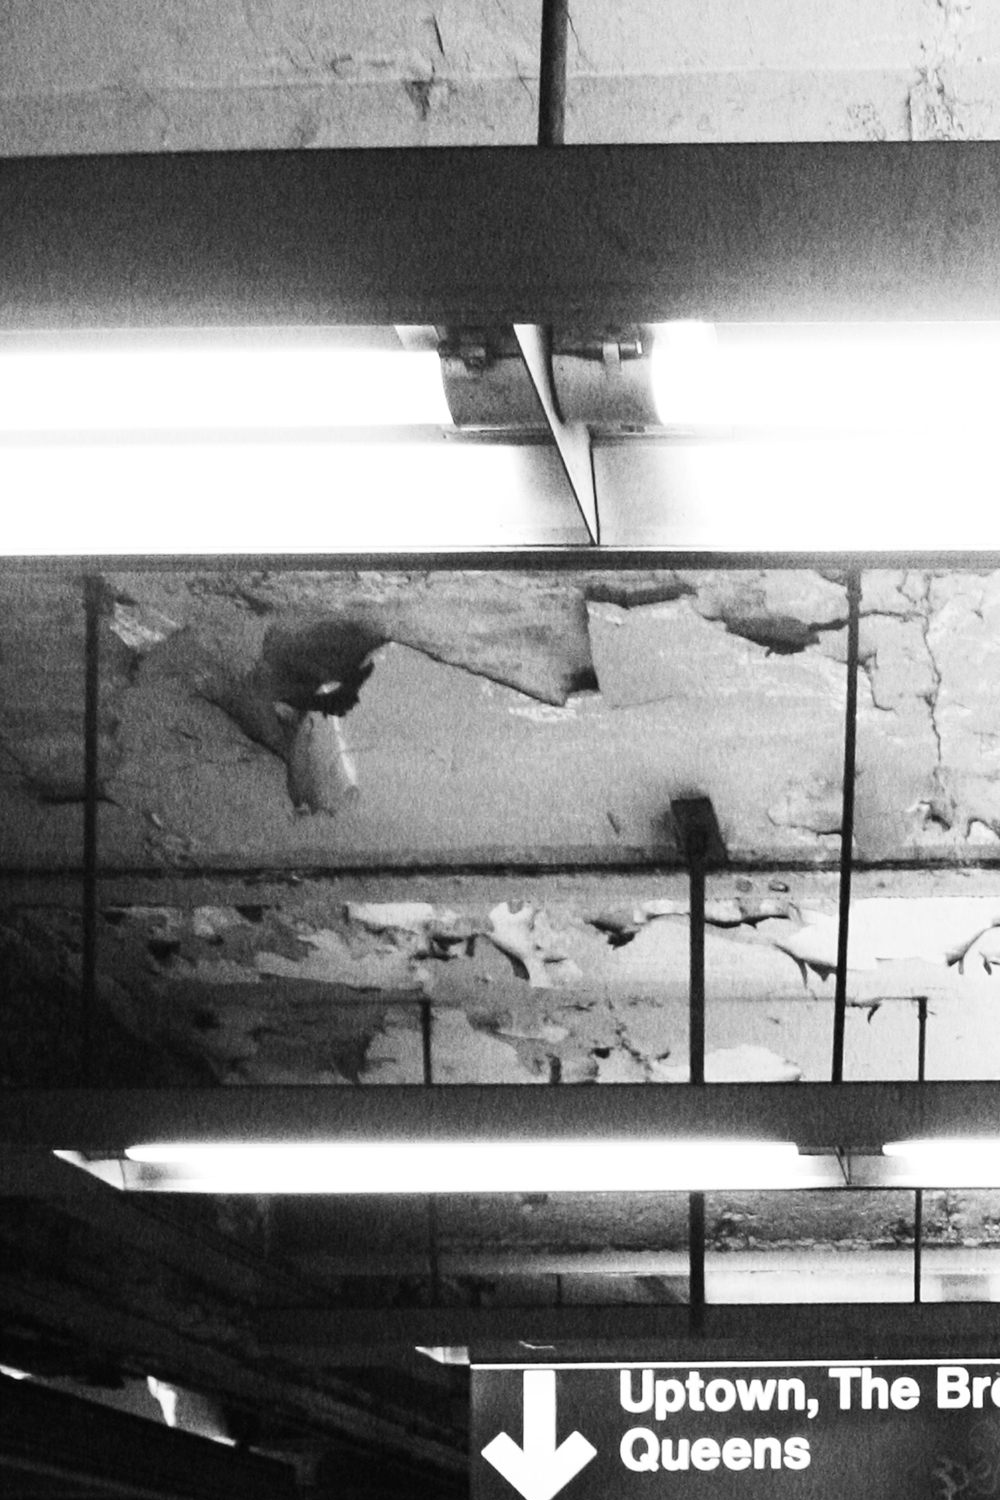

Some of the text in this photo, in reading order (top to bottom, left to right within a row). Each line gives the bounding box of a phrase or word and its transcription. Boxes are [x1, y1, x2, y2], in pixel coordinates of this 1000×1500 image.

[619, 1368, 819, 1421] Uptown,
[828, 1367, 921, 1410] The
[619, 1426, 812, 1473] Queens
